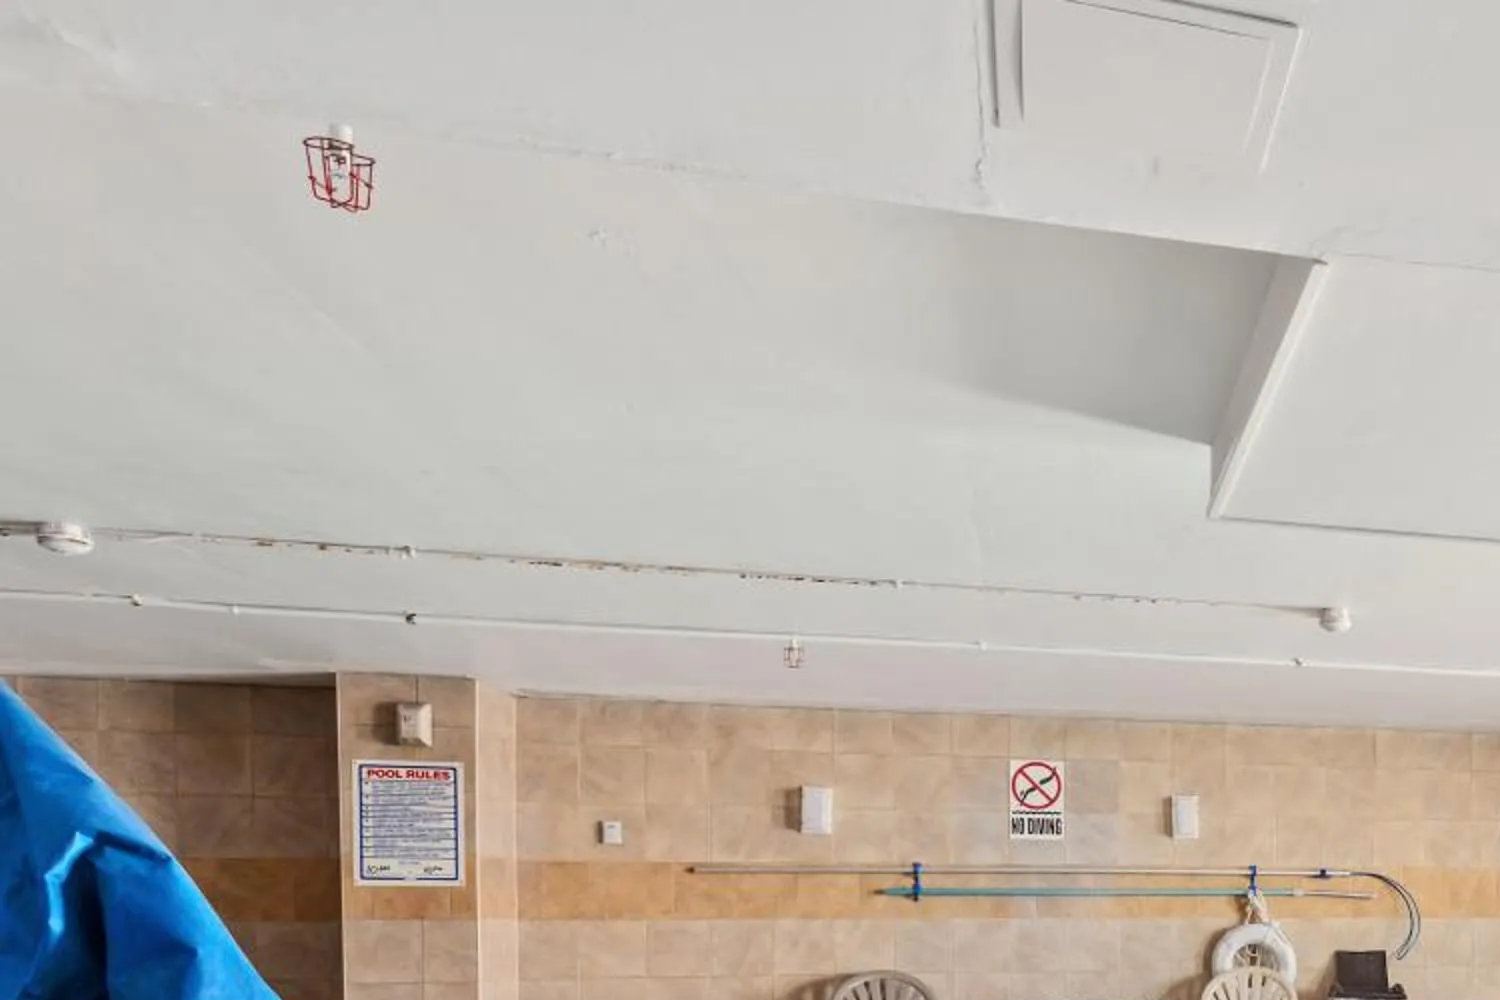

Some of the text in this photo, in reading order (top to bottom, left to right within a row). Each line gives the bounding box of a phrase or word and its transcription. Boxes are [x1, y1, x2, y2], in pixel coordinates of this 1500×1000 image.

[367, 769, 451, 780] POOL RULES
[1012, 818, 1063, 835] NO DIVING
